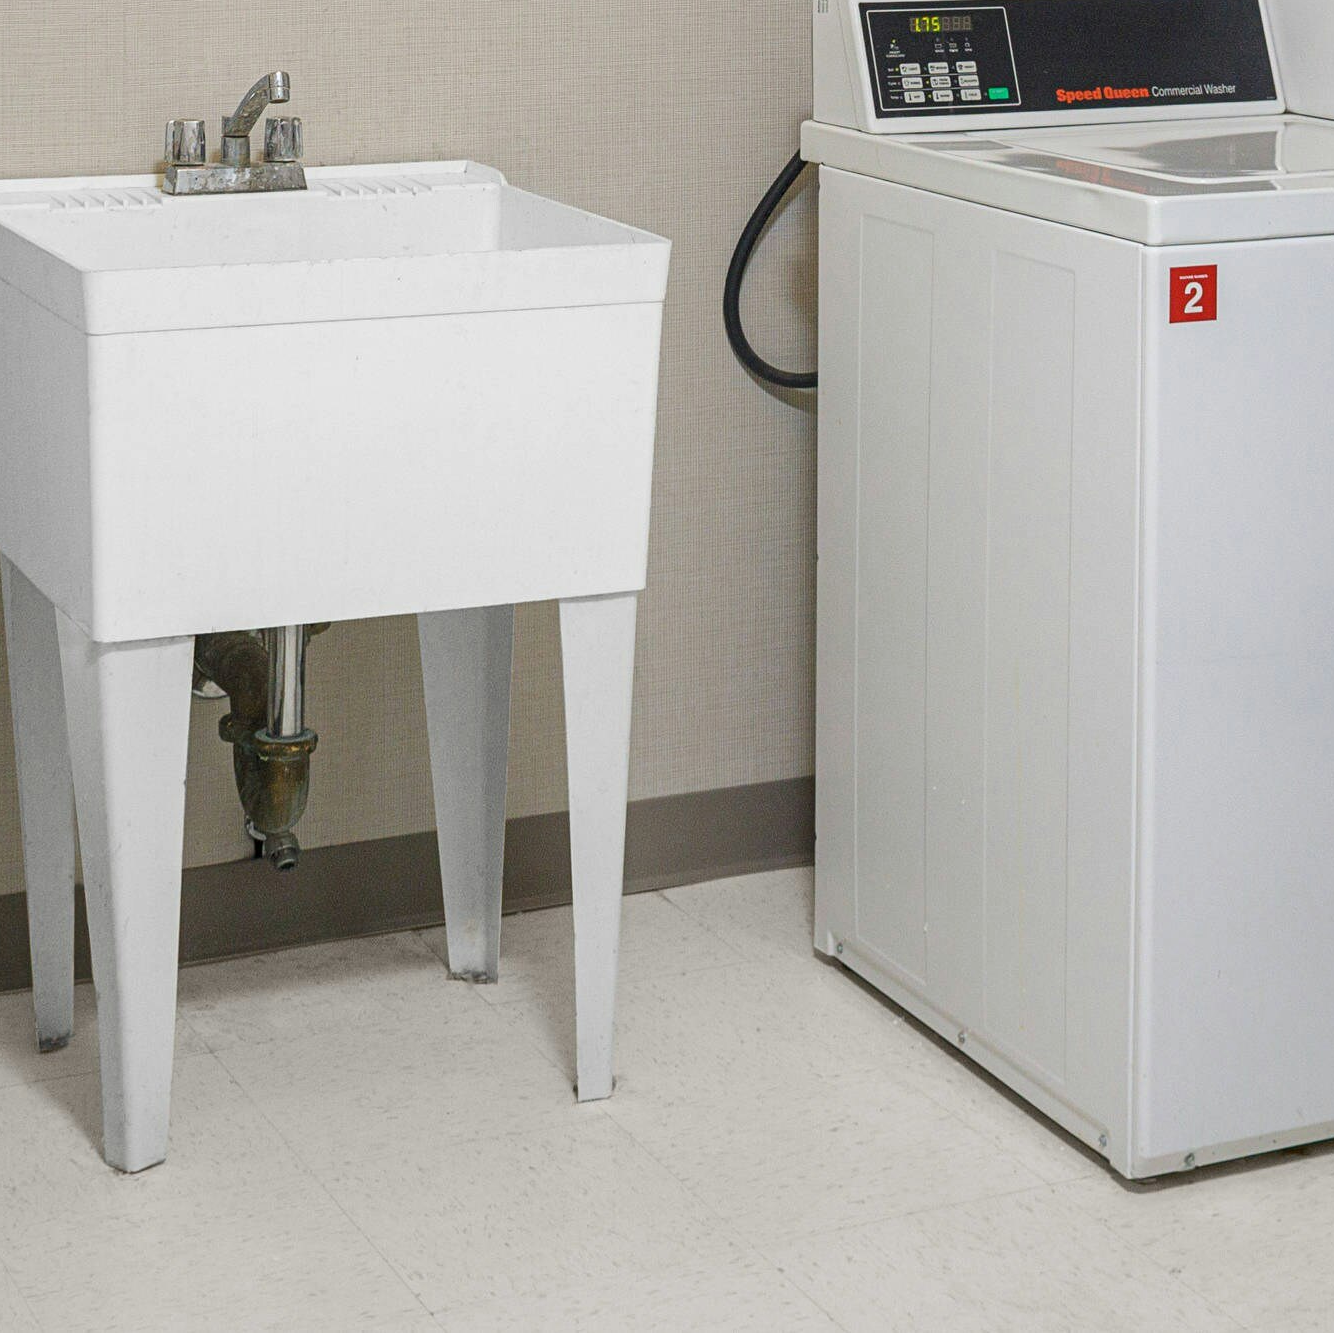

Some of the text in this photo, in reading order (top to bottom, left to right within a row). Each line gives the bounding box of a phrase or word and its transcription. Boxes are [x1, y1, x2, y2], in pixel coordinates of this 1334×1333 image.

[1056, 84, 1236, 104] Speed Queen Commercial Washer
[1184, 282, 1203, 313] 2
